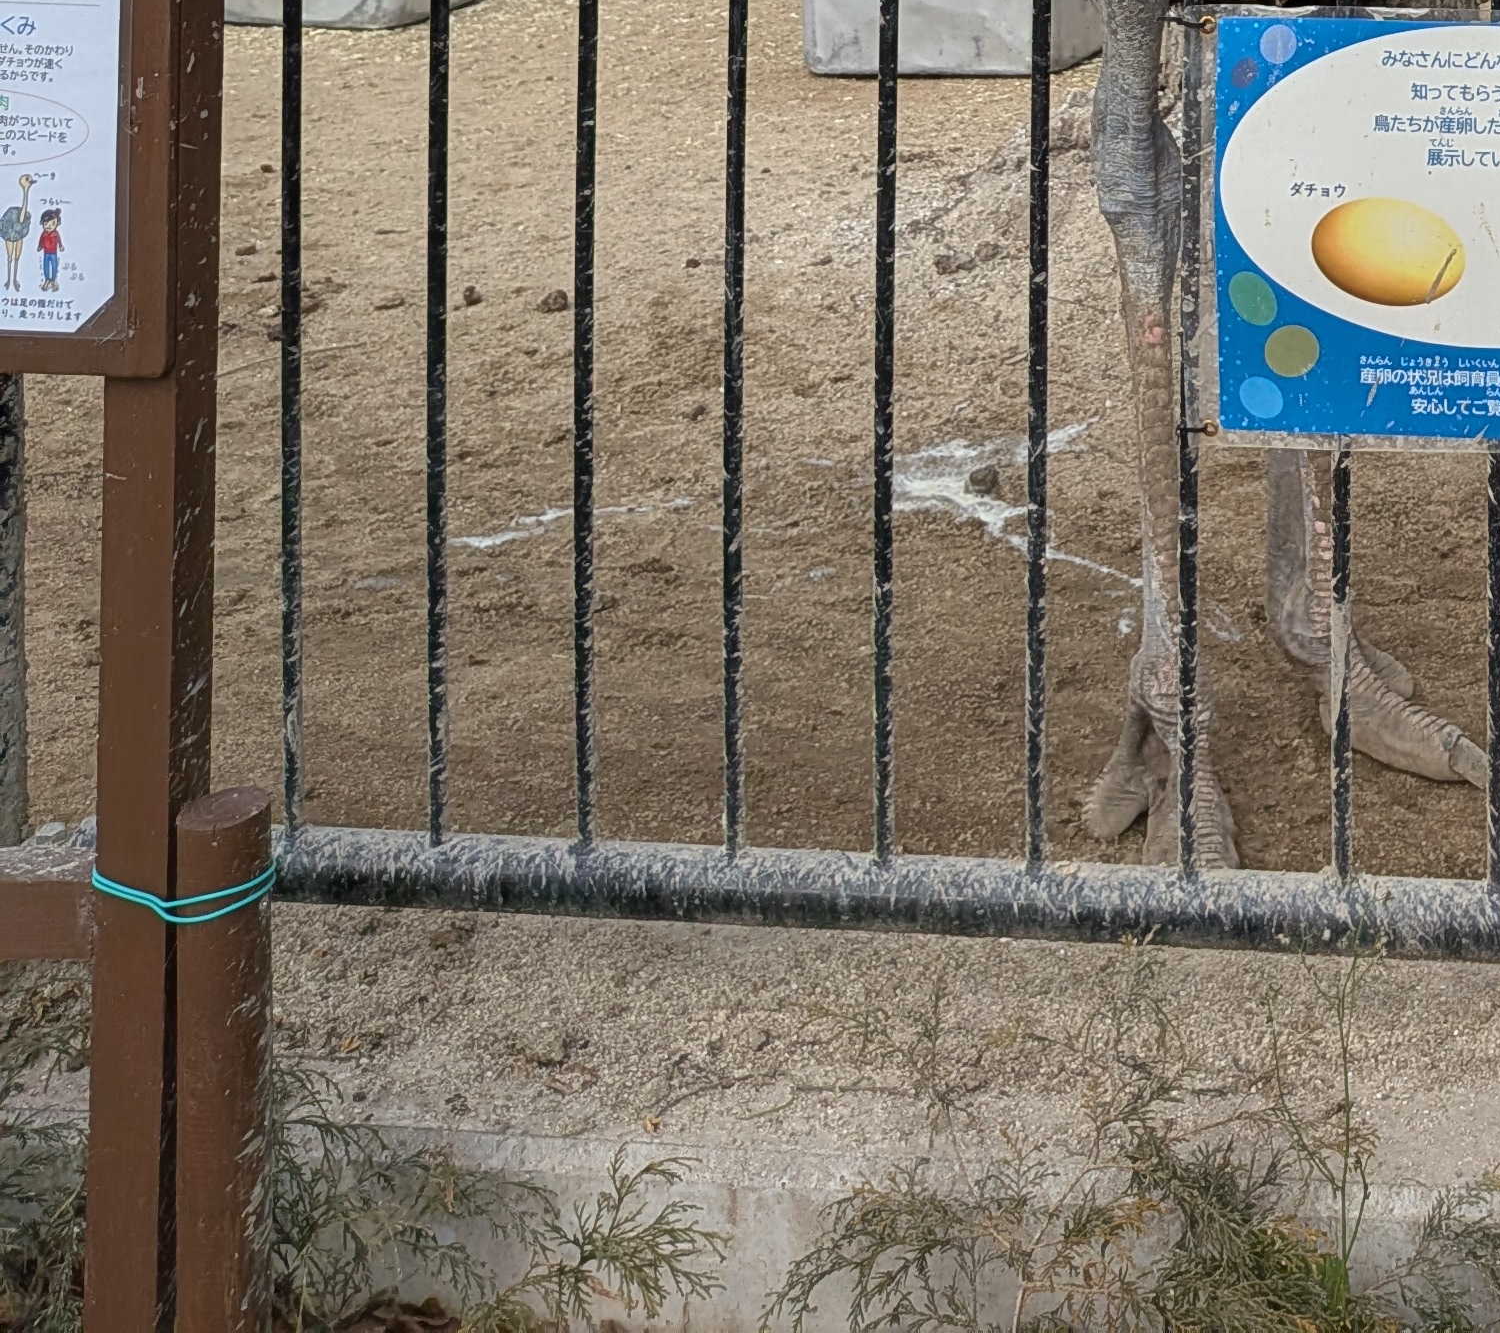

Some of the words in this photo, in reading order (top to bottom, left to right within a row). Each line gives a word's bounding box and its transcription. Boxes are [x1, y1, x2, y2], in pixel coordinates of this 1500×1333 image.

[0, 15, 37, 36] くみ
[1439, 106, 1473, 116] さんらん
[1429, 138, 1454, 148] てんじ
[1290, 181, 1346, 198] ダチョウ
[1359, 355, 1393, 365] さんらん
[1400, 356, 1448, 367] じょうきょう
[1458, 357, 1500, 368] しいくいん
[1409, 386, 1443, 396] あんしん
